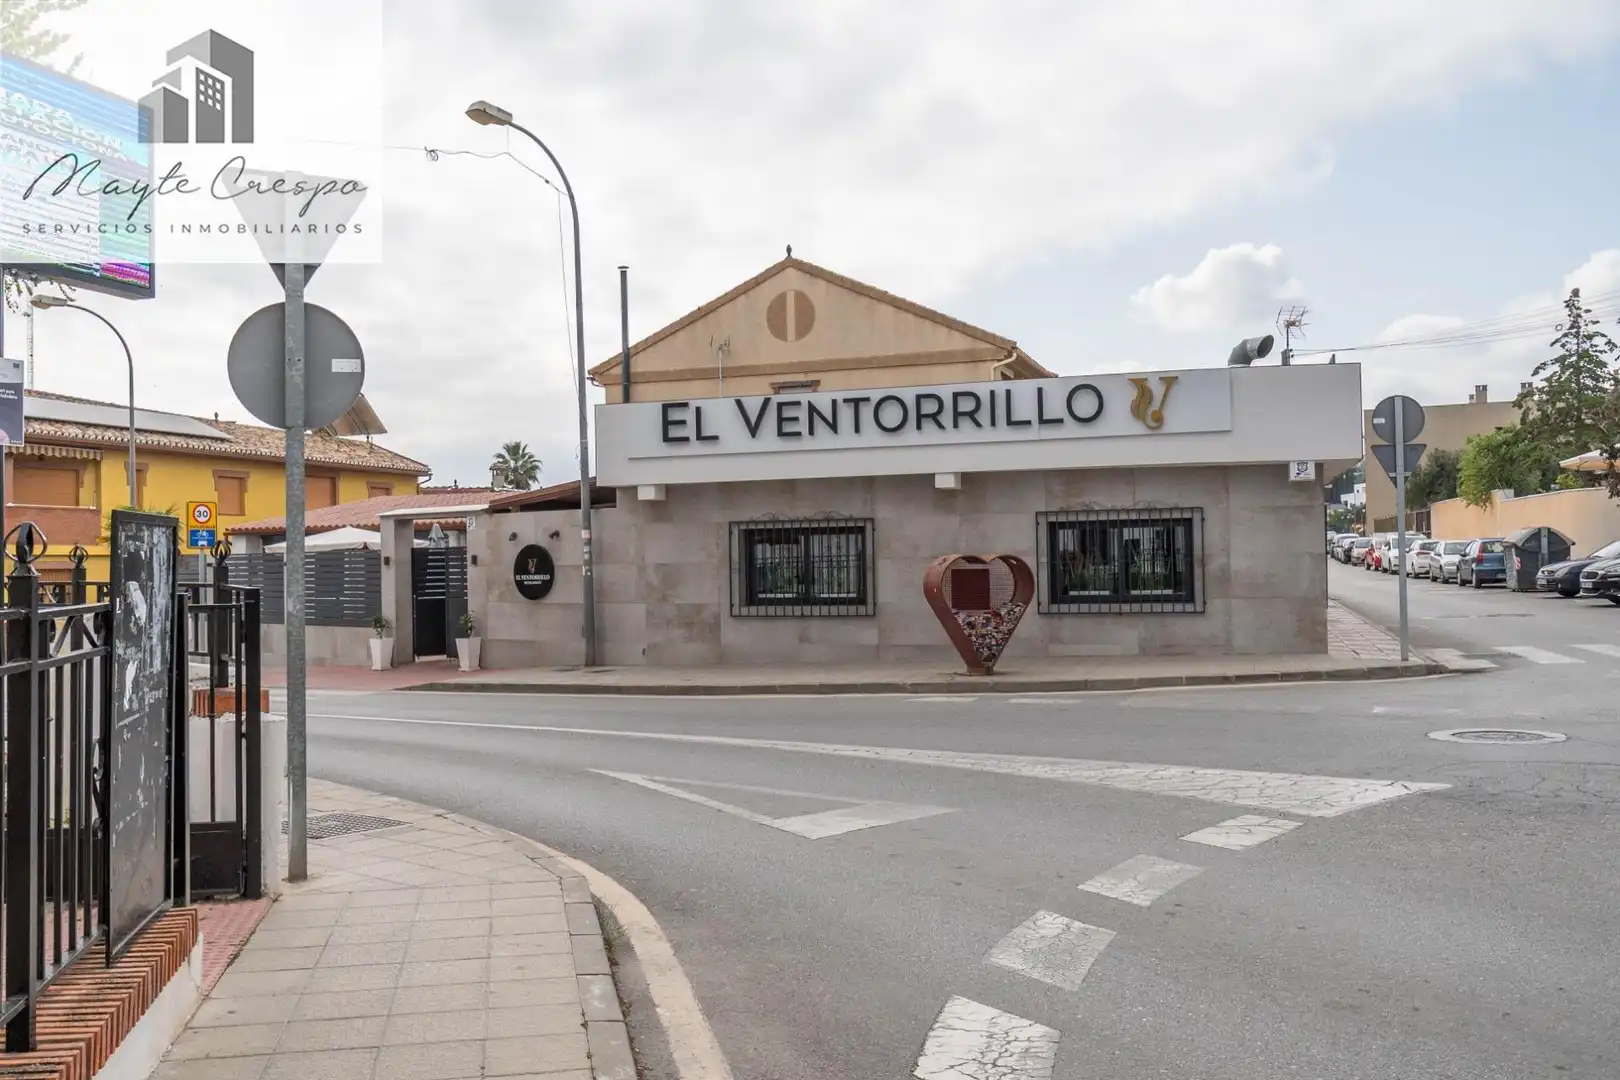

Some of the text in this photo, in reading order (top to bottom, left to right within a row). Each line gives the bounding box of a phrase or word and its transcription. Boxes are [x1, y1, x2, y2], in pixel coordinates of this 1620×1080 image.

[661, 383, 1104, 443] EL VENTORRILLO
[196, 510, 209, 518] 30
